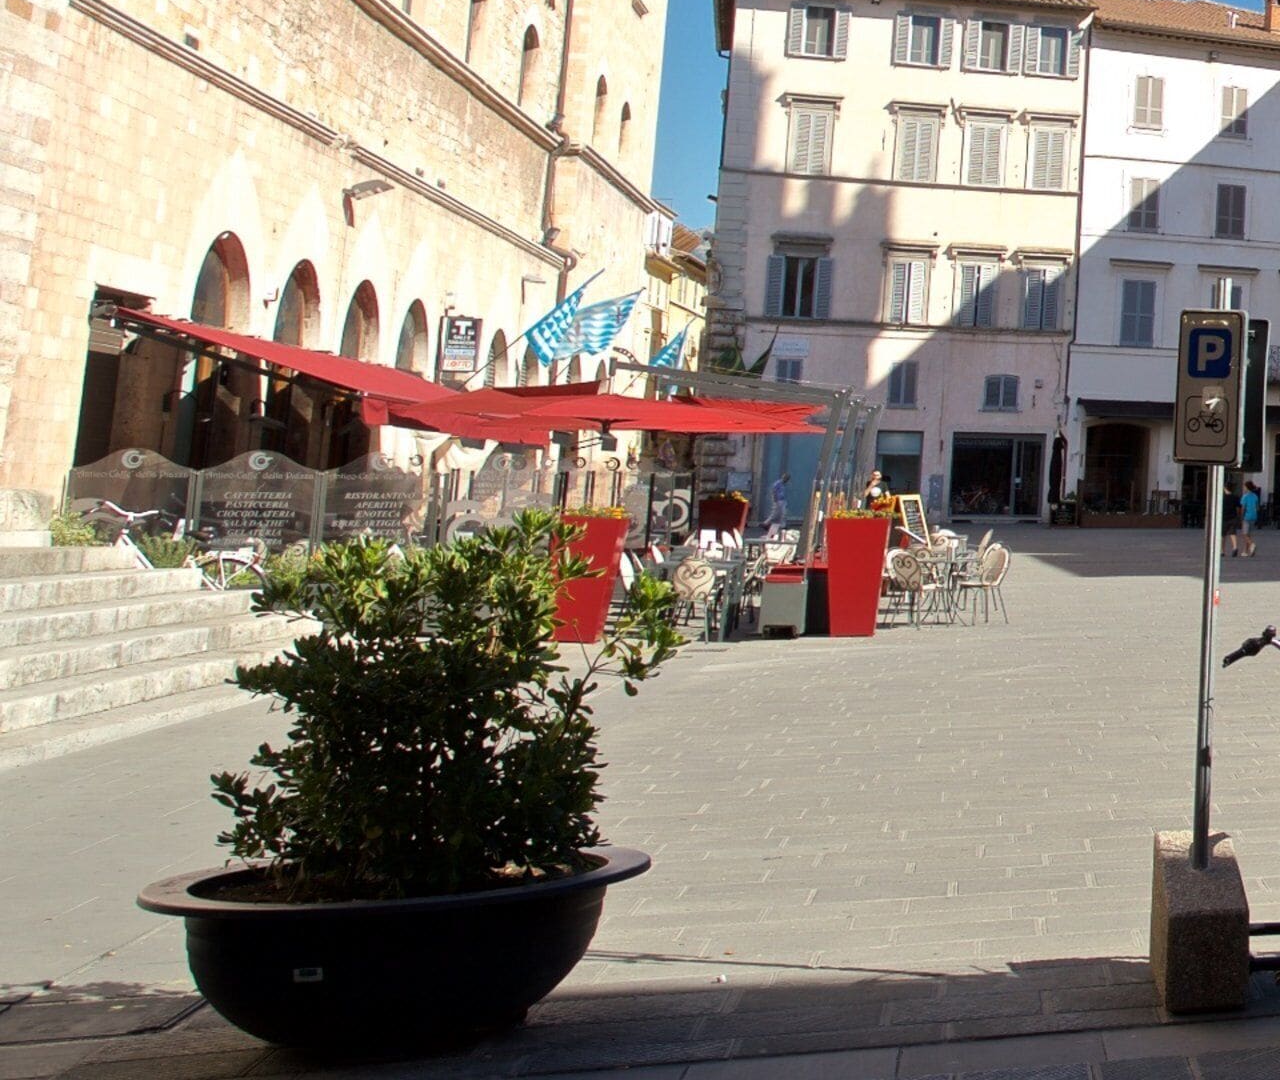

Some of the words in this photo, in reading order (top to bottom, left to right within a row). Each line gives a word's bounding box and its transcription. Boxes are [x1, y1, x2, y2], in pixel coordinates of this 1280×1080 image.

[455, 321, 472, 335] T
[1197, 335, 1225, 372] P
[223, 491, 293, 500] CAFFETTERIA
[344, 491, 416, 500] RISTORANTINO
[225, 501, 289, 509] PASTICCERIA
[354, 501, 404, 509] APERITIVI
[354, 510, 401, 518] ENOTECA
